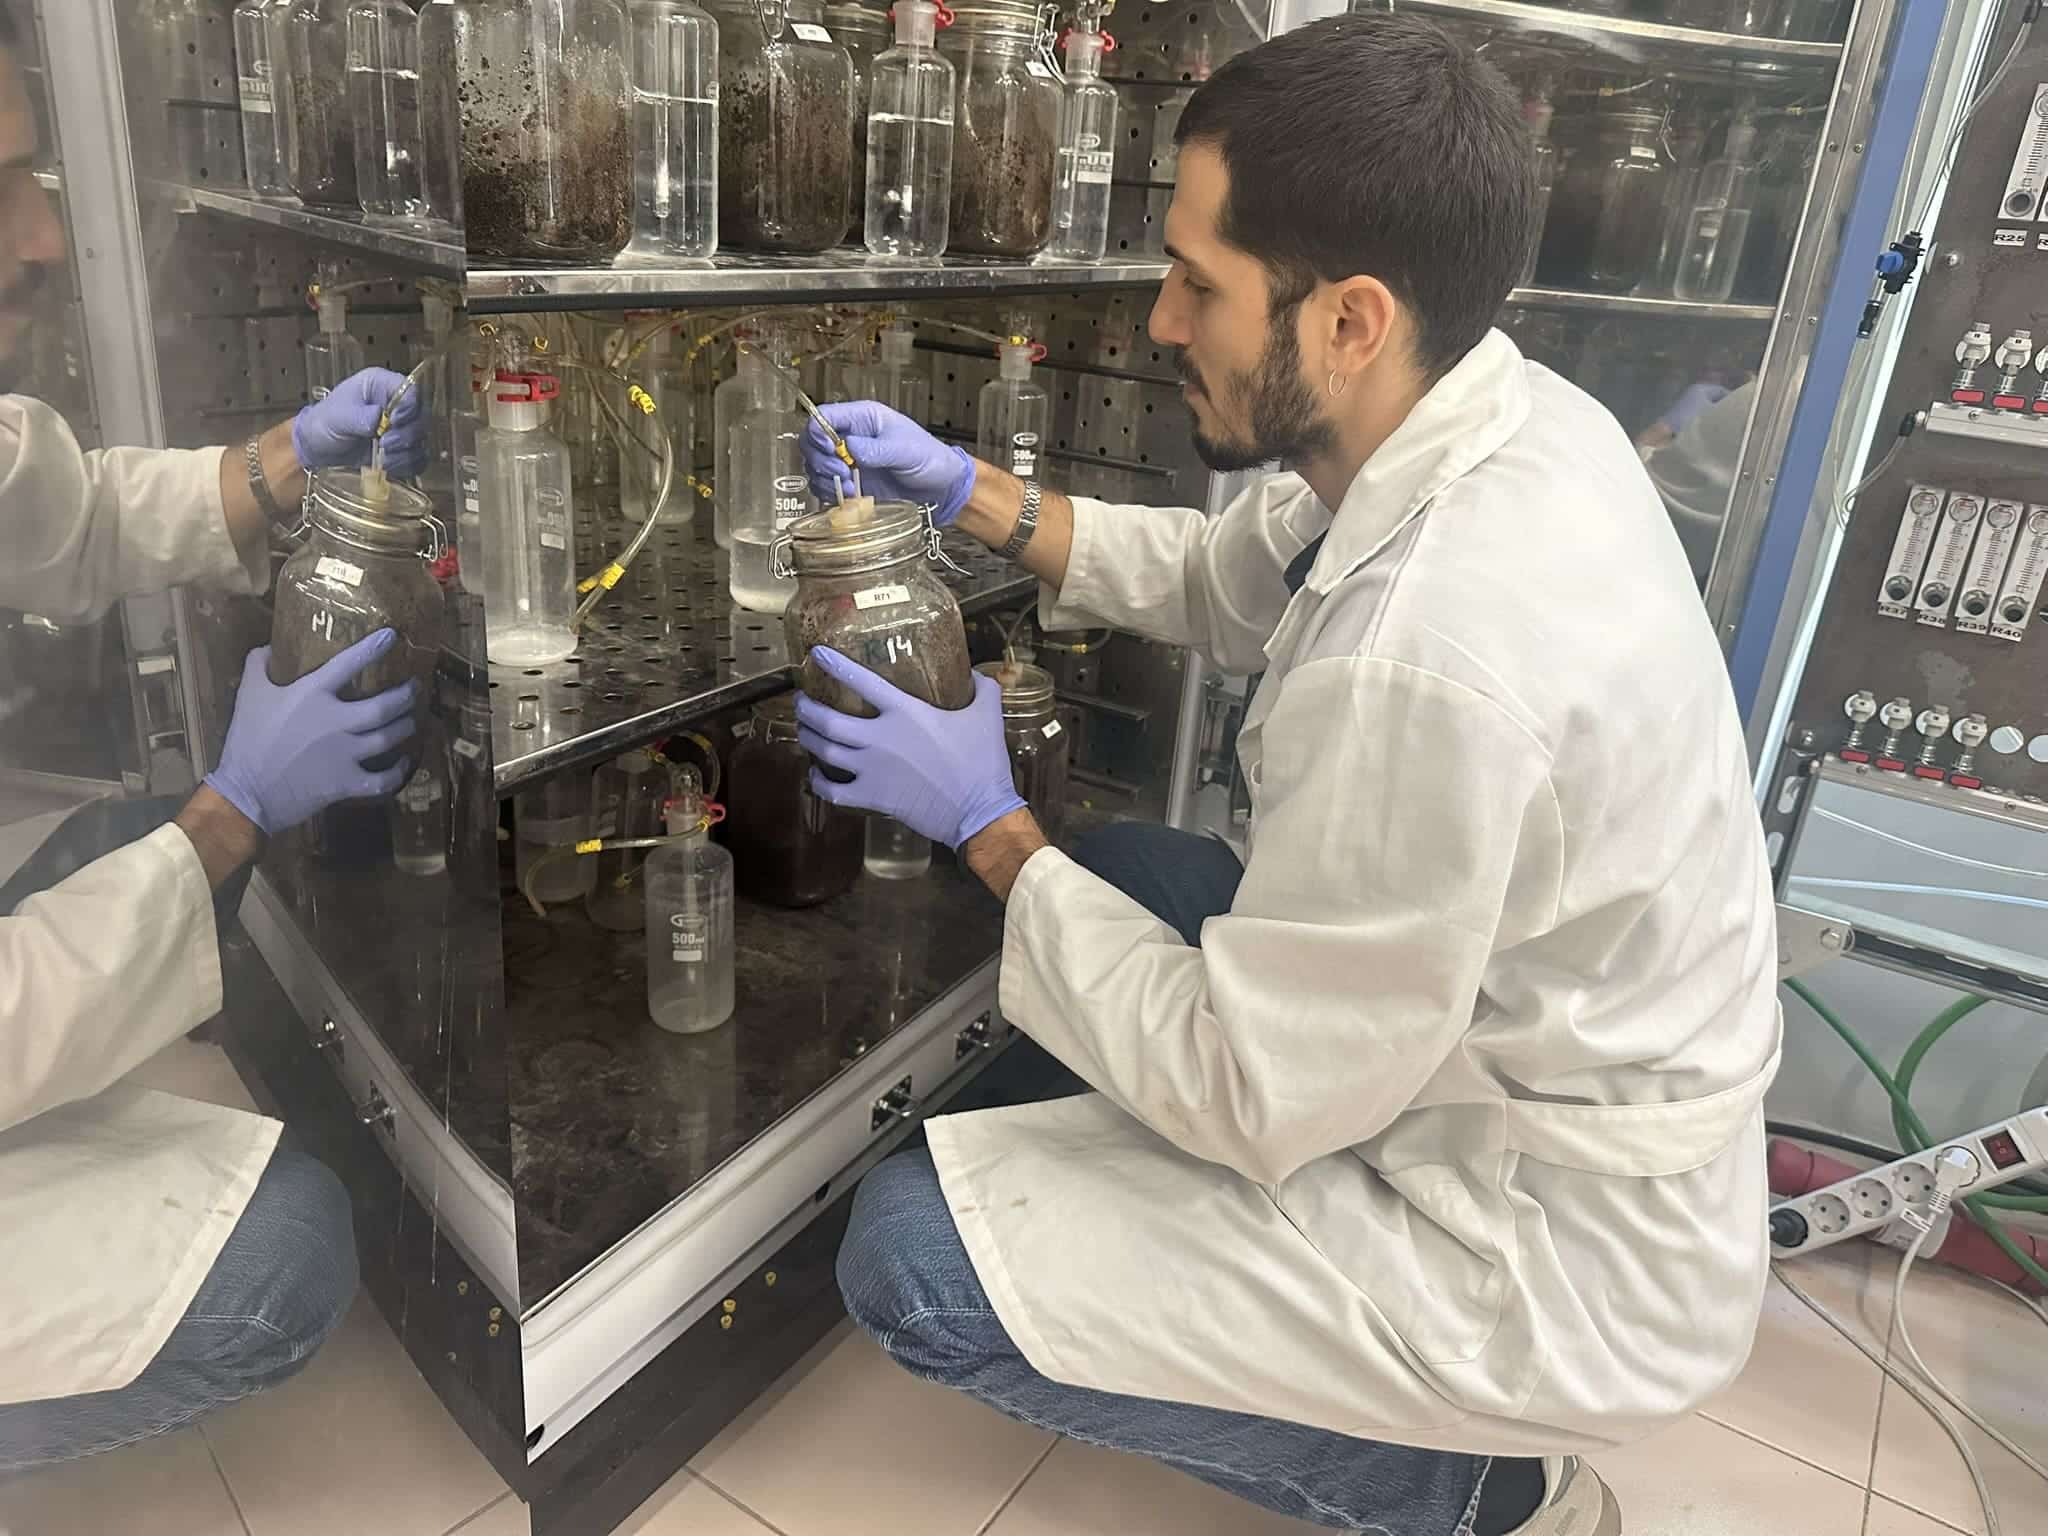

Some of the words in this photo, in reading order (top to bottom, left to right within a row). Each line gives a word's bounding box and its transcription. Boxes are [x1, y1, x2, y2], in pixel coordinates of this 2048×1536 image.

[1995, 234, 2025, 242] R25
[1992, 625, 2022, 639] R40
[886, 634, 913, 665] 14
